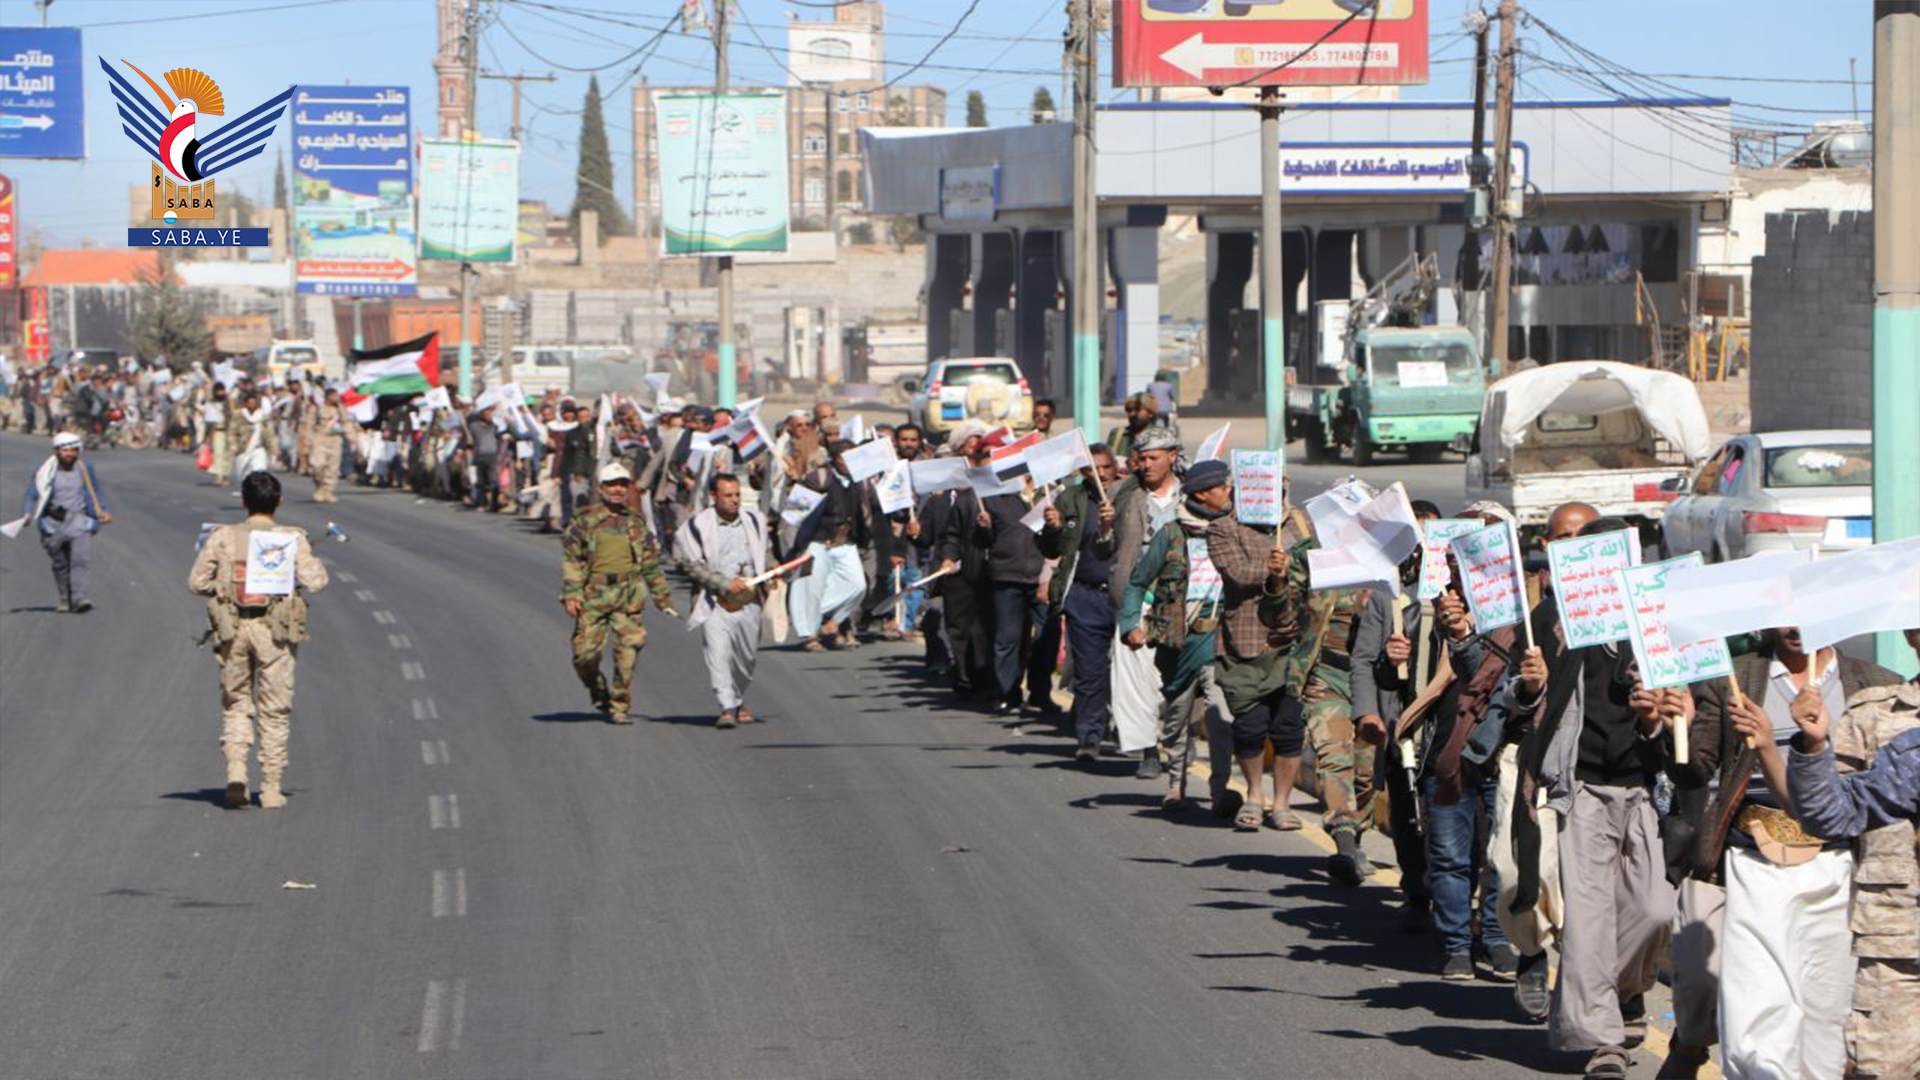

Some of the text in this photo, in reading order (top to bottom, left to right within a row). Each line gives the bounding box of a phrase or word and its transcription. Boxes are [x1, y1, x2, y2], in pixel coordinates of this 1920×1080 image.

[0, 49, 55, 71] منتج
[1559, 540, 1625, 568] الله أكبر
